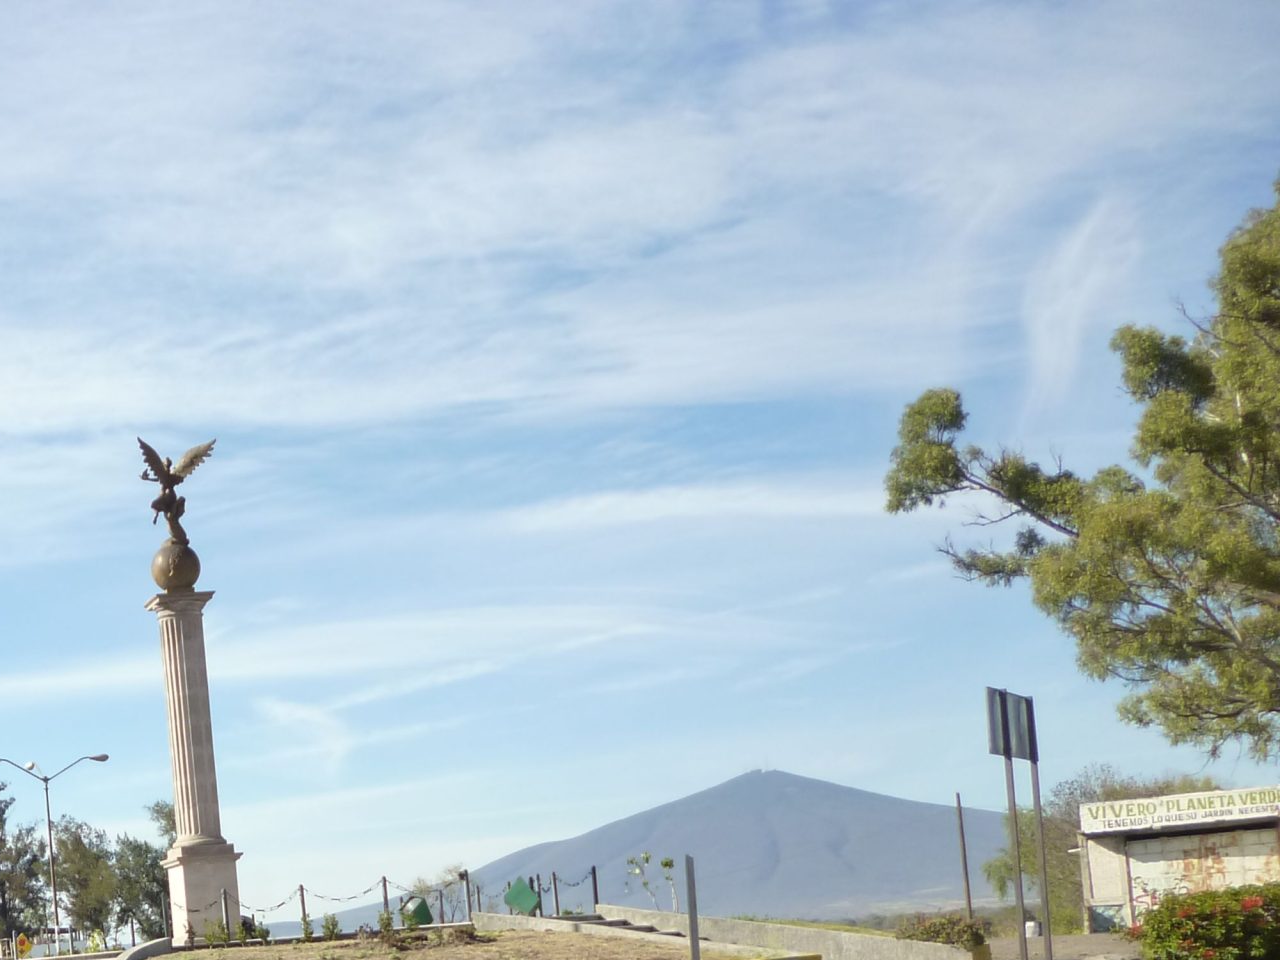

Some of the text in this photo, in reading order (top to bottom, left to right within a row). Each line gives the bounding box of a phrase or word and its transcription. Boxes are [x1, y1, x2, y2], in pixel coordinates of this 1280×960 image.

[1088, 802, 1157, 820] VIVERO
[1102, 816, 1148, 829] TENEMOS
[1152, 815, 1163, 824] LO
[1201, 809, 1233, 819] JARDIN
